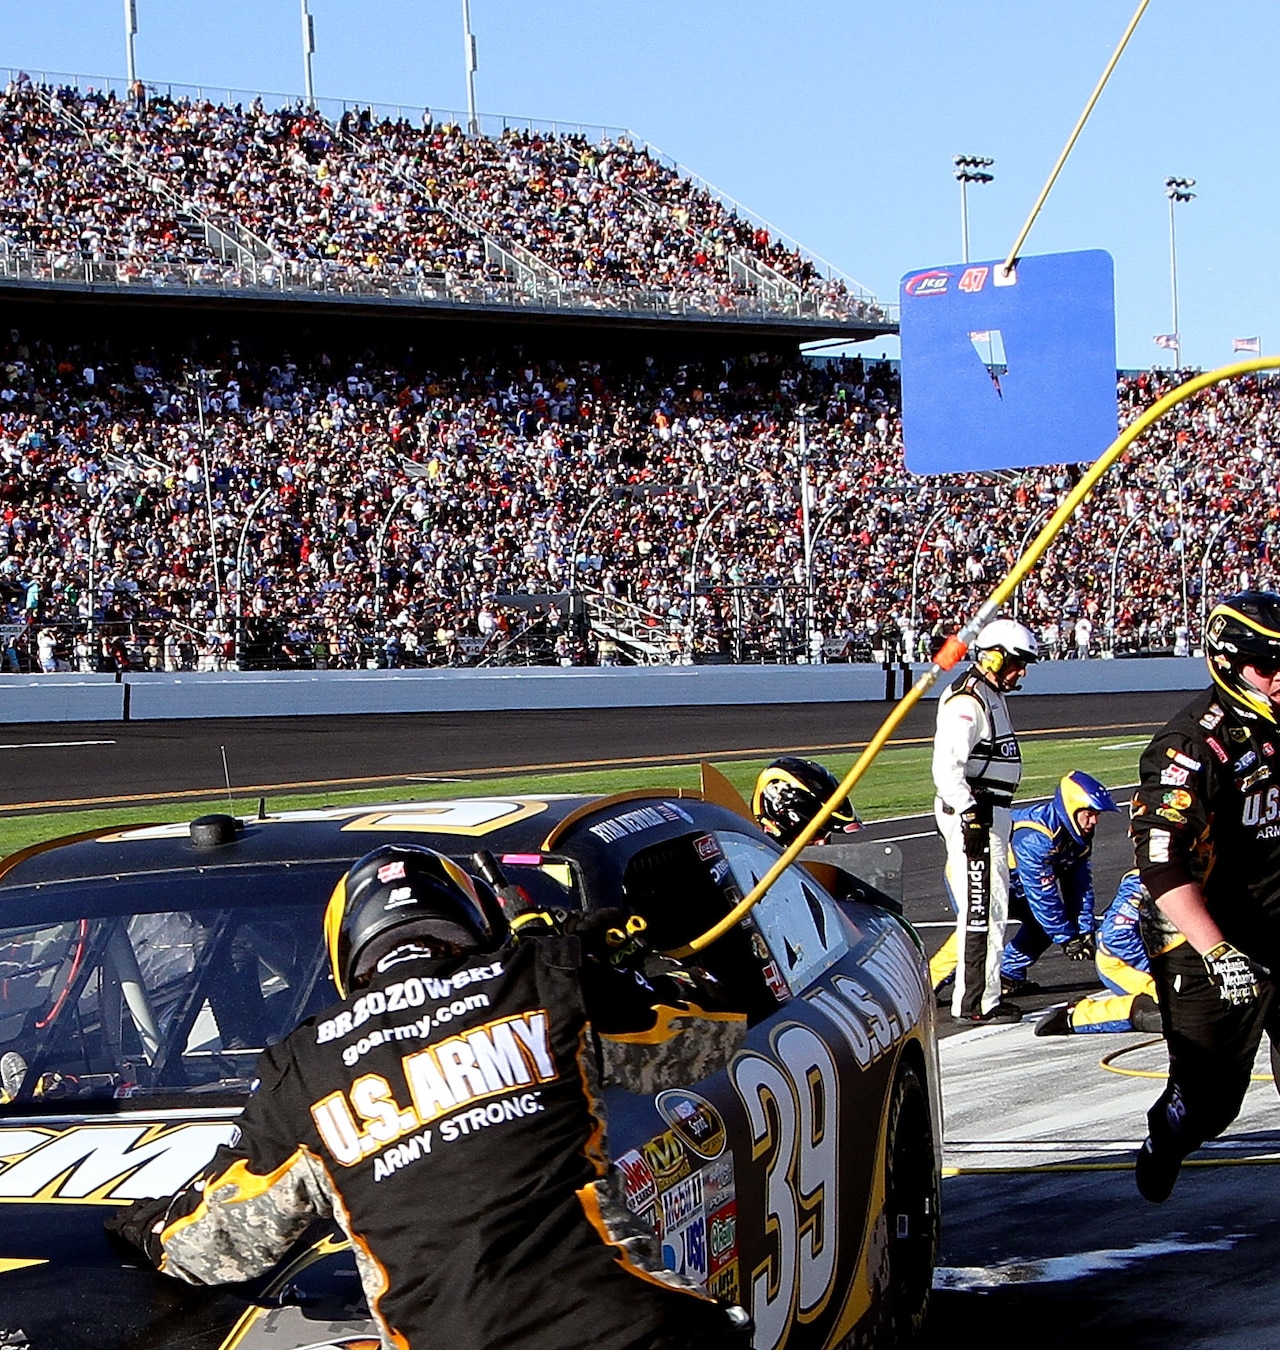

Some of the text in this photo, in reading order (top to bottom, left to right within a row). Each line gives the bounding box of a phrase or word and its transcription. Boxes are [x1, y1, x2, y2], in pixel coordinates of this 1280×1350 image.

[959, 267, 989, 293] 47
[588, 818, 627, 844] RYAN
[968, 860, 986, 915] Sprint
[316, 961, 506, 1044] BRZOZOWSKI
[341, 993, 490, 1066] goarmy.com
[310, 1009, 559, 1168] U.S. ARMY
[373, 1131, 433, 1183] ARMY
